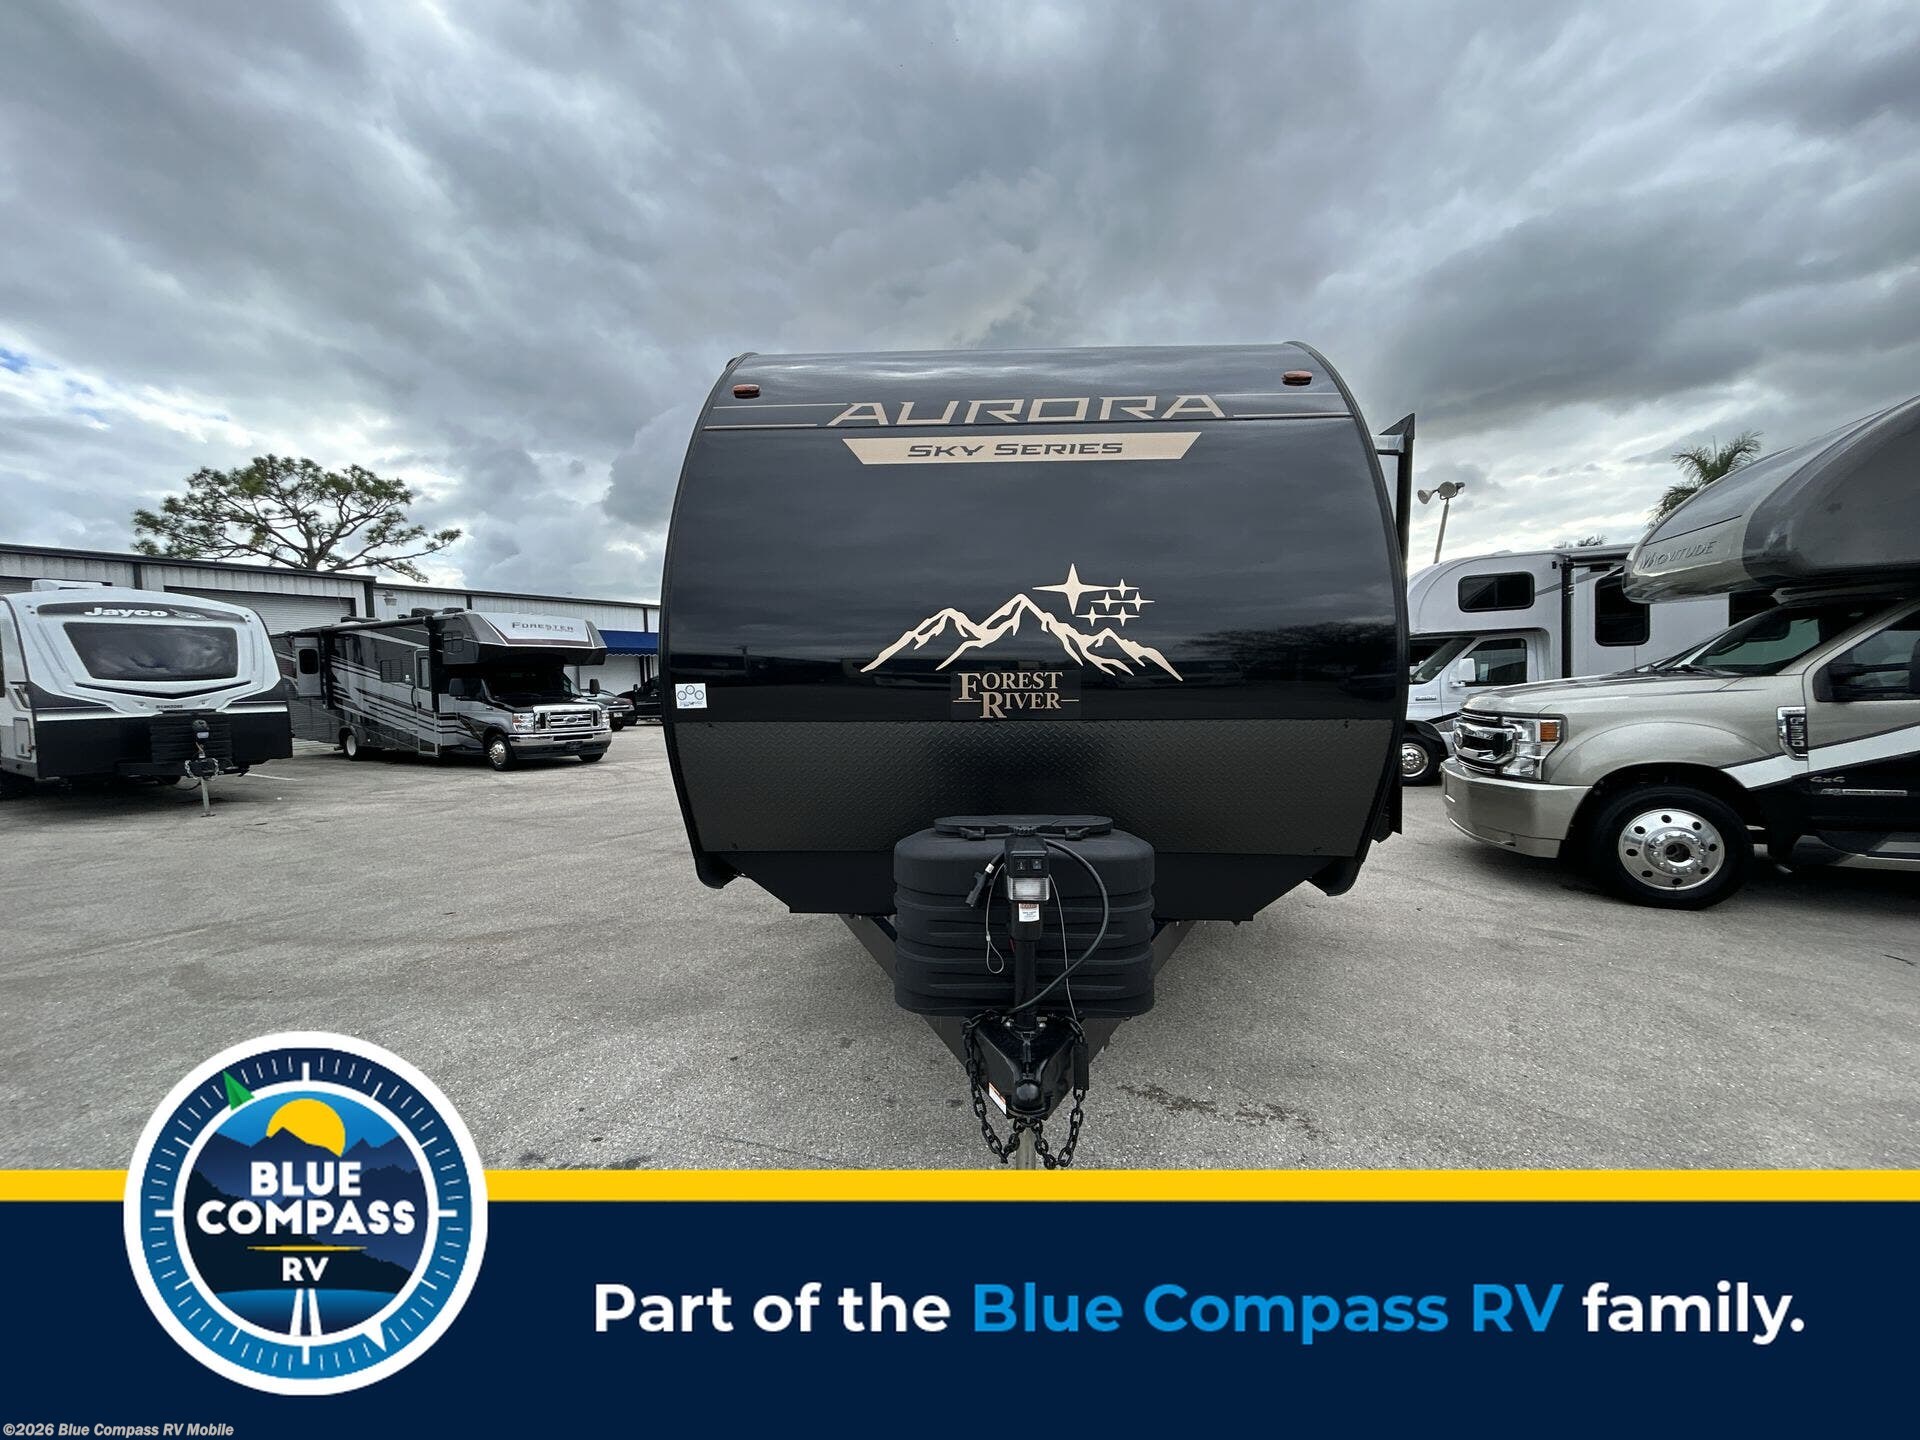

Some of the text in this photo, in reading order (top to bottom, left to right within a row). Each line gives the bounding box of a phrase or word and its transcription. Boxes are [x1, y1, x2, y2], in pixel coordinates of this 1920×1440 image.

[826, 394, 1226, 427] AURORA
[907, 442, 1123, 458] SKY SERIES
[84, 607, 168, 618] Jayco
[511, 621, 575, 634] FORESTER
[957, 671, 1064, 700] FOREST
[979, 691, 1062, 719] RIVER
